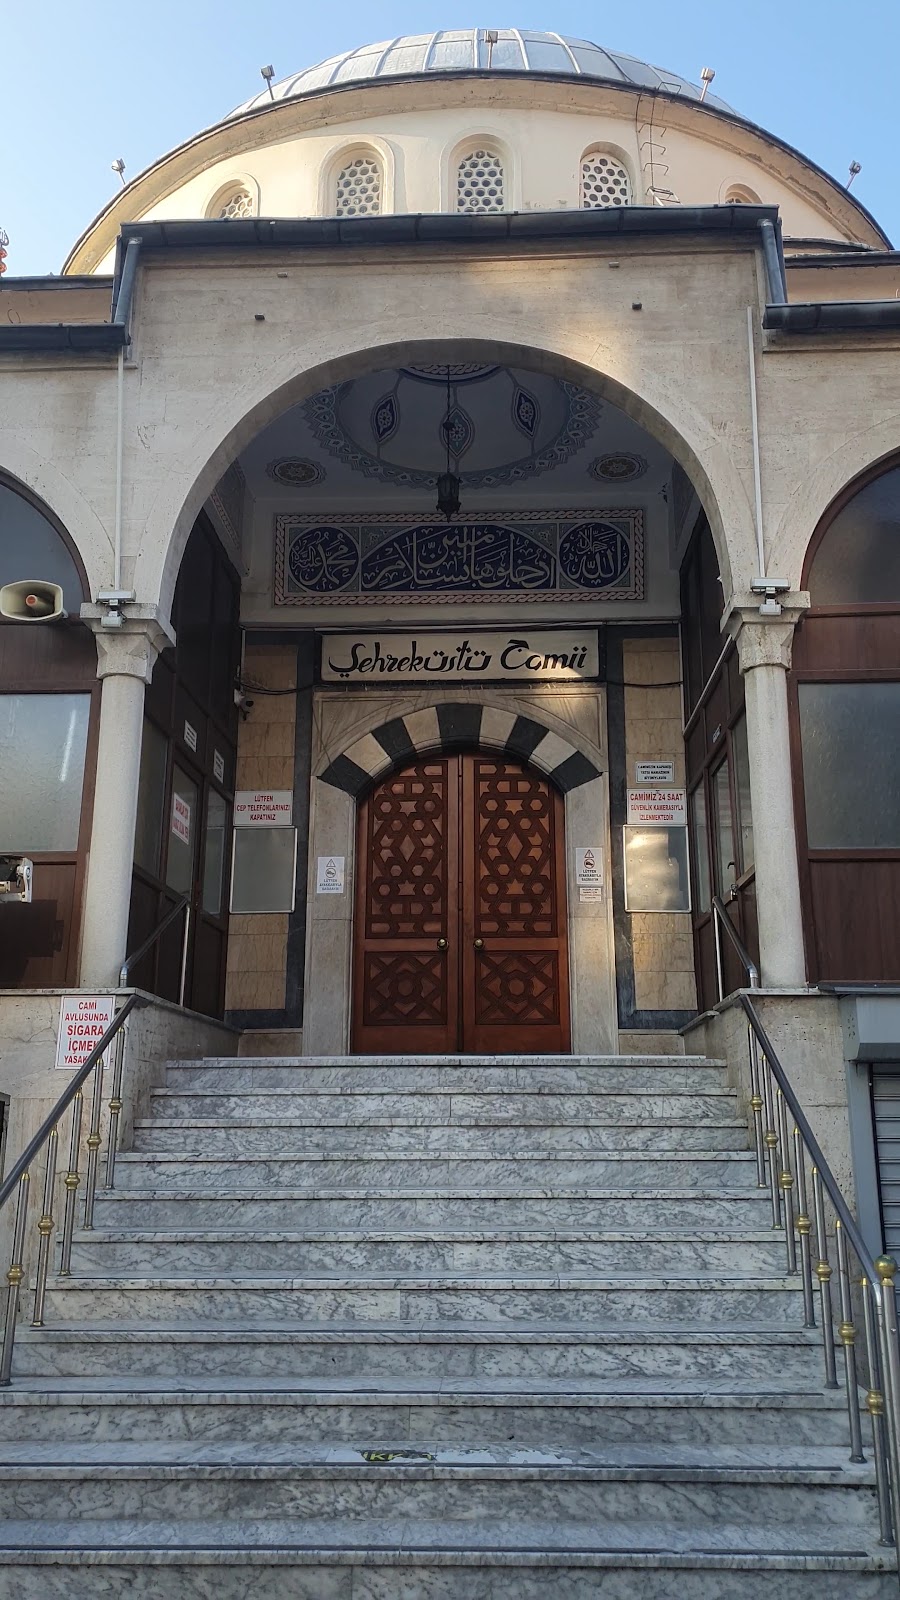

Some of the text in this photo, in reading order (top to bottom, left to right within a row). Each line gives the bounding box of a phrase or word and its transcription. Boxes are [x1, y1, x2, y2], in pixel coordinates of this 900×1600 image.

[500, 639, 588, 671] Camii
[630, 792, 656, 800] CAMİMİZ
[78, 1000, 97, 1010] CAMİ
[64, 1013, 109, 1022] AVLUSUNDA
[67, 1022, 104, 1036] SİGARA
